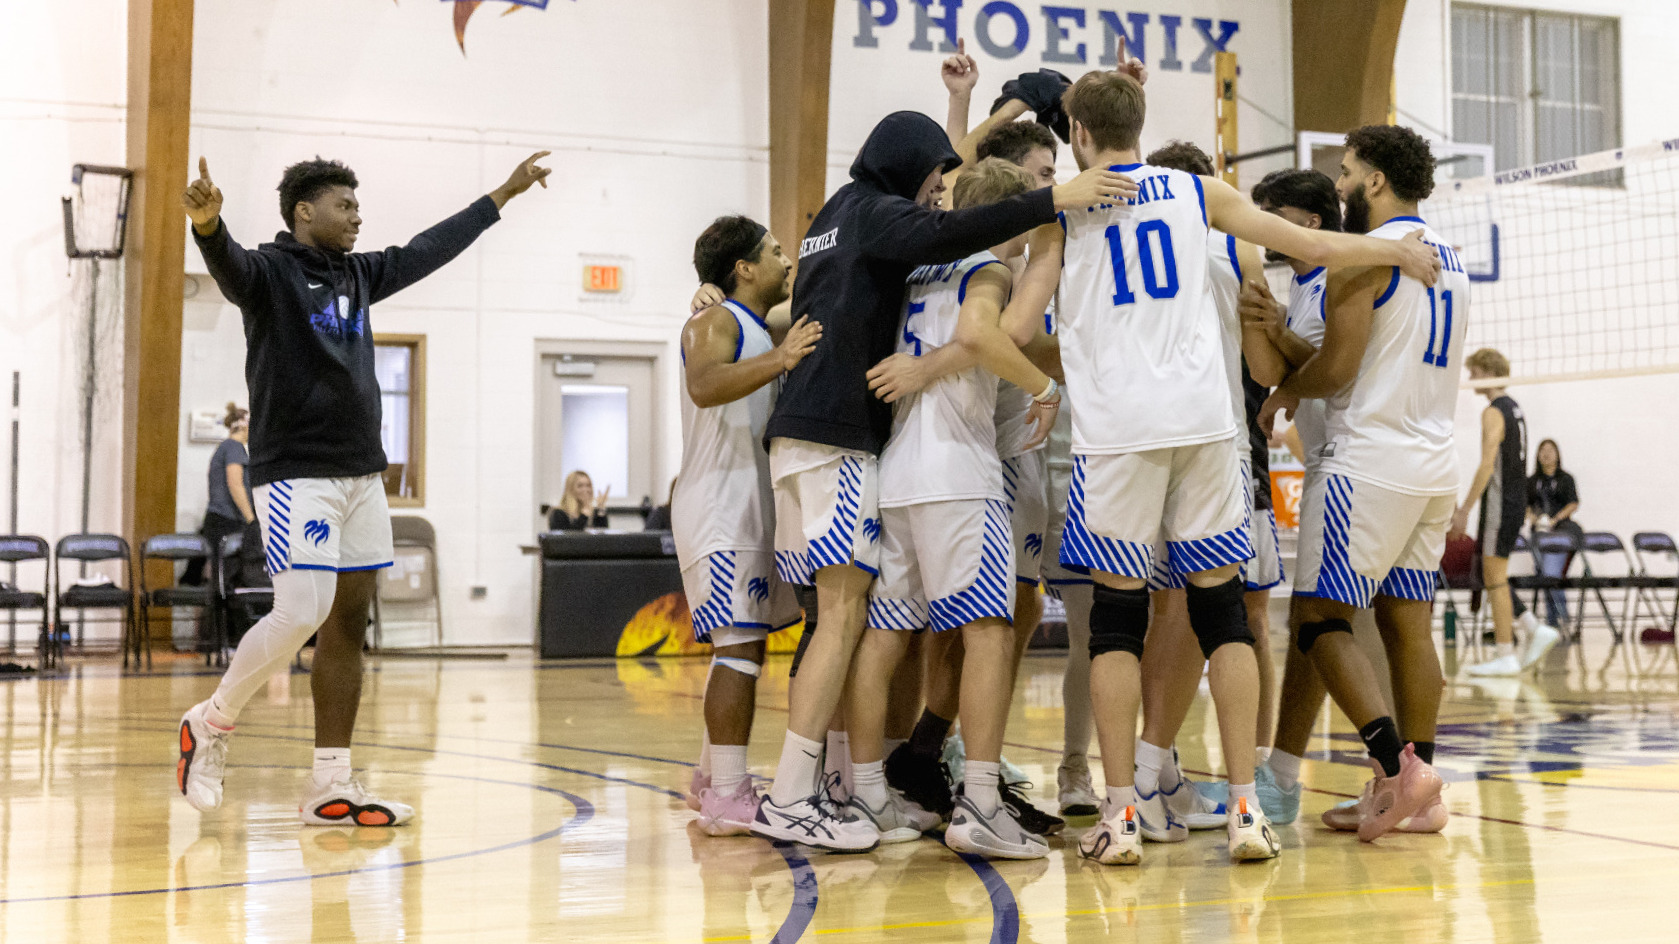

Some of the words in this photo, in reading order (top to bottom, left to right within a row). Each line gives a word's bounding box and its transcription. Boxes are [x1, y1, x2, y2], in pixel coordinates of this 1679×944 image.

[853, 0, 1240, 75] PHOENIX
[1495, 169, 1532, 185] WILSON
[1534, 160, 1577, 179] PHOENIX
[591, 266, 618, 289] EXIT
[1104, 219, 1180, 306] 10
[903, 301, 926, 356] 5
[1422, 287, 1453, 368] 11
